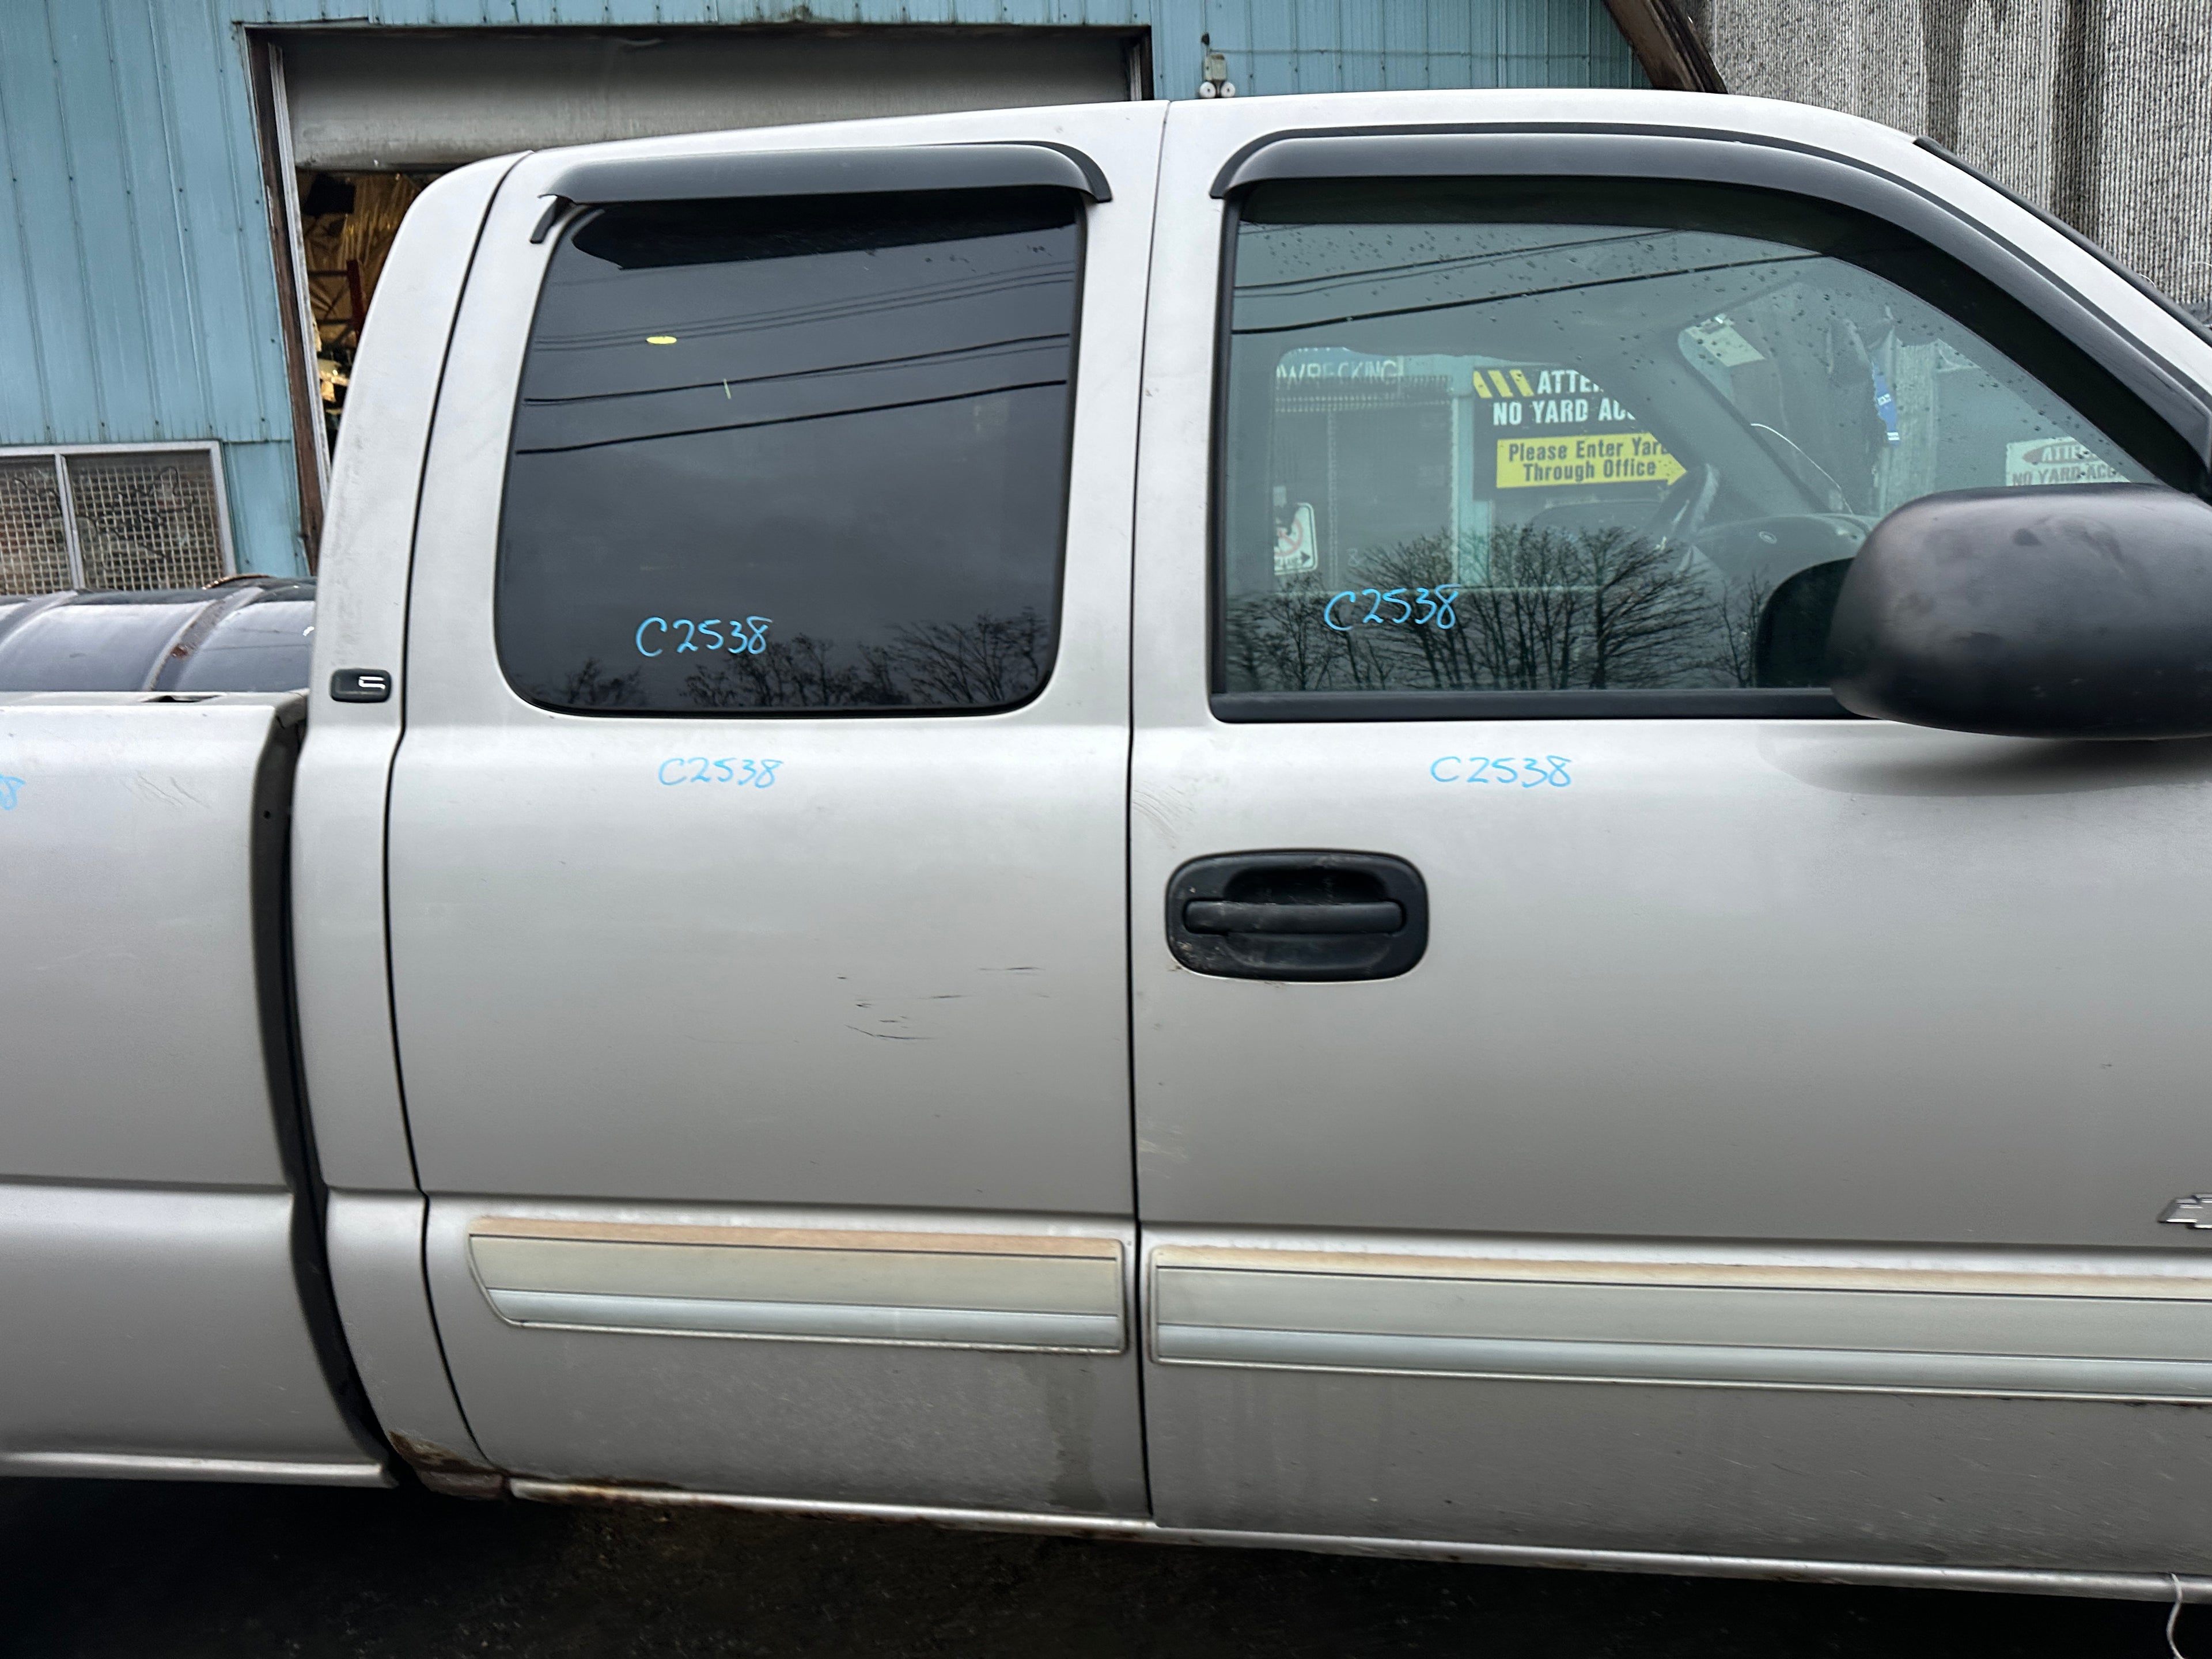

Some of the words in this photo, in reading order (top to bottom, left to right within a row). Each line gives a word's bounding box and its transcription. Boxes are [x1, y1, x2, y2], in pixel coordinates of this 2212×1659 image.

[1493, 402, 1522, 426] NO
[1532, 399, 1589, 423] YARD
[1509, 442, 1567, 461] Please
[1576, 440, 1623, 459] Enter
[1523, 461, 1594, 483] Through
[1603, 459, 1656, 478] Office
[2012, 471, 2033, 485] NO
[2037, 465, 2083, 484] YARD
[1324, 584, 1461, 631] C2538
[635, 615, 773, 657] C2538
[658, 757, 784, 789] C2538
[1430, 755, 1571, 788] C2538
